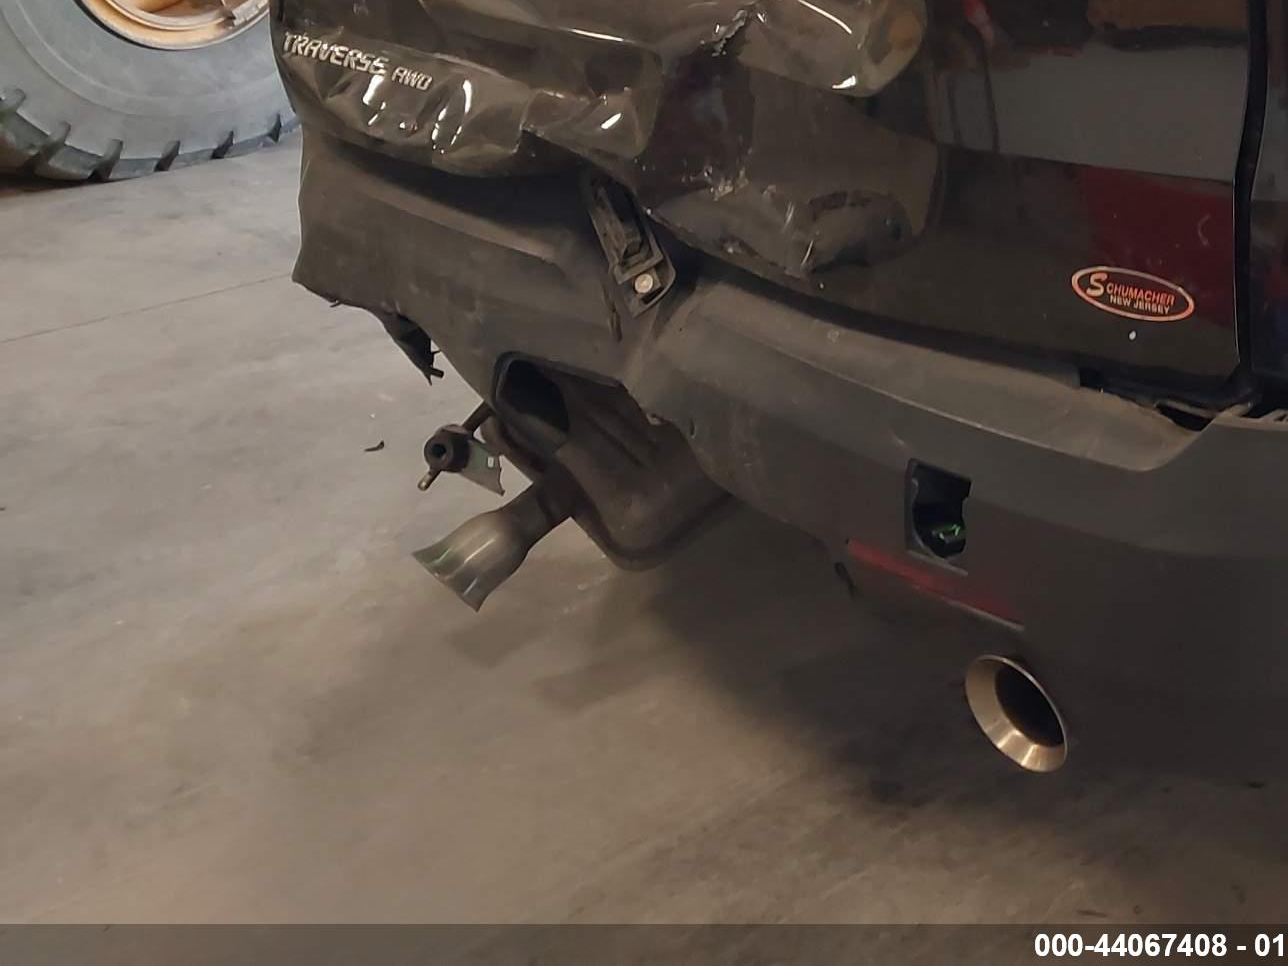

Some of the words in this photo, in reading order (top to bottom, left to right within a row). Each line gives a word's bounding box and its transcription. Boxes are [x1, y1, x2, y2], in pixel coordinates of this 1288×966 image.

[283, 32, 389, 76] TRAVERSE
[391, 56, 433, 91] AWD
[1086, 272, 1175, 307] SCHUMACHER
[1109, 294, 1132, 308] NEW
[1133, 298, 1171, 315] JERSEY
